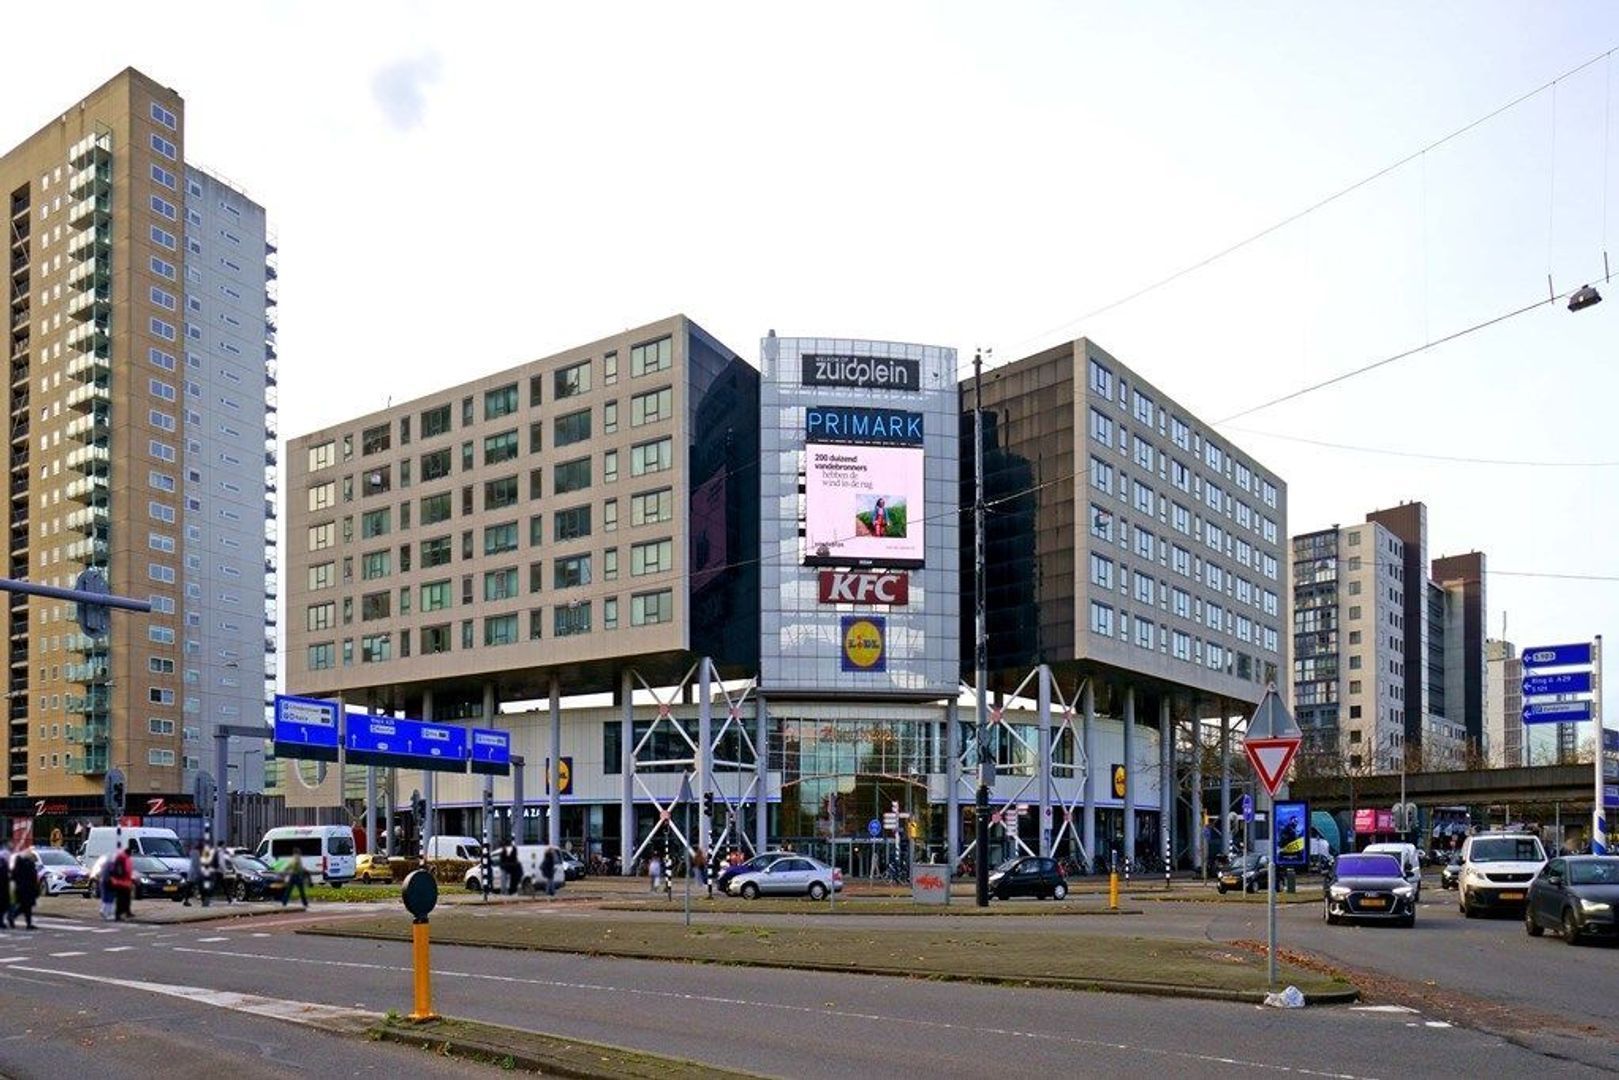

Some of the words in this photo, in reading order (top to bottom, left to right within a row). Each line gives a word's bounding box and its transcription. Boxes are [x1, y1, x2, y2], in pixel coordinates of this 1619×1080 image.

[815, 358, 908, 385] zuidplein
[808, 412, 921, 437] PRIMARK
[814, 453, 828, 462] 200
[829, 454, 858, 463] duizend
[822, 471, 848, 479] hebben
[849, 471, 858, 479] de
[828, 573, 900, 602] KFC
